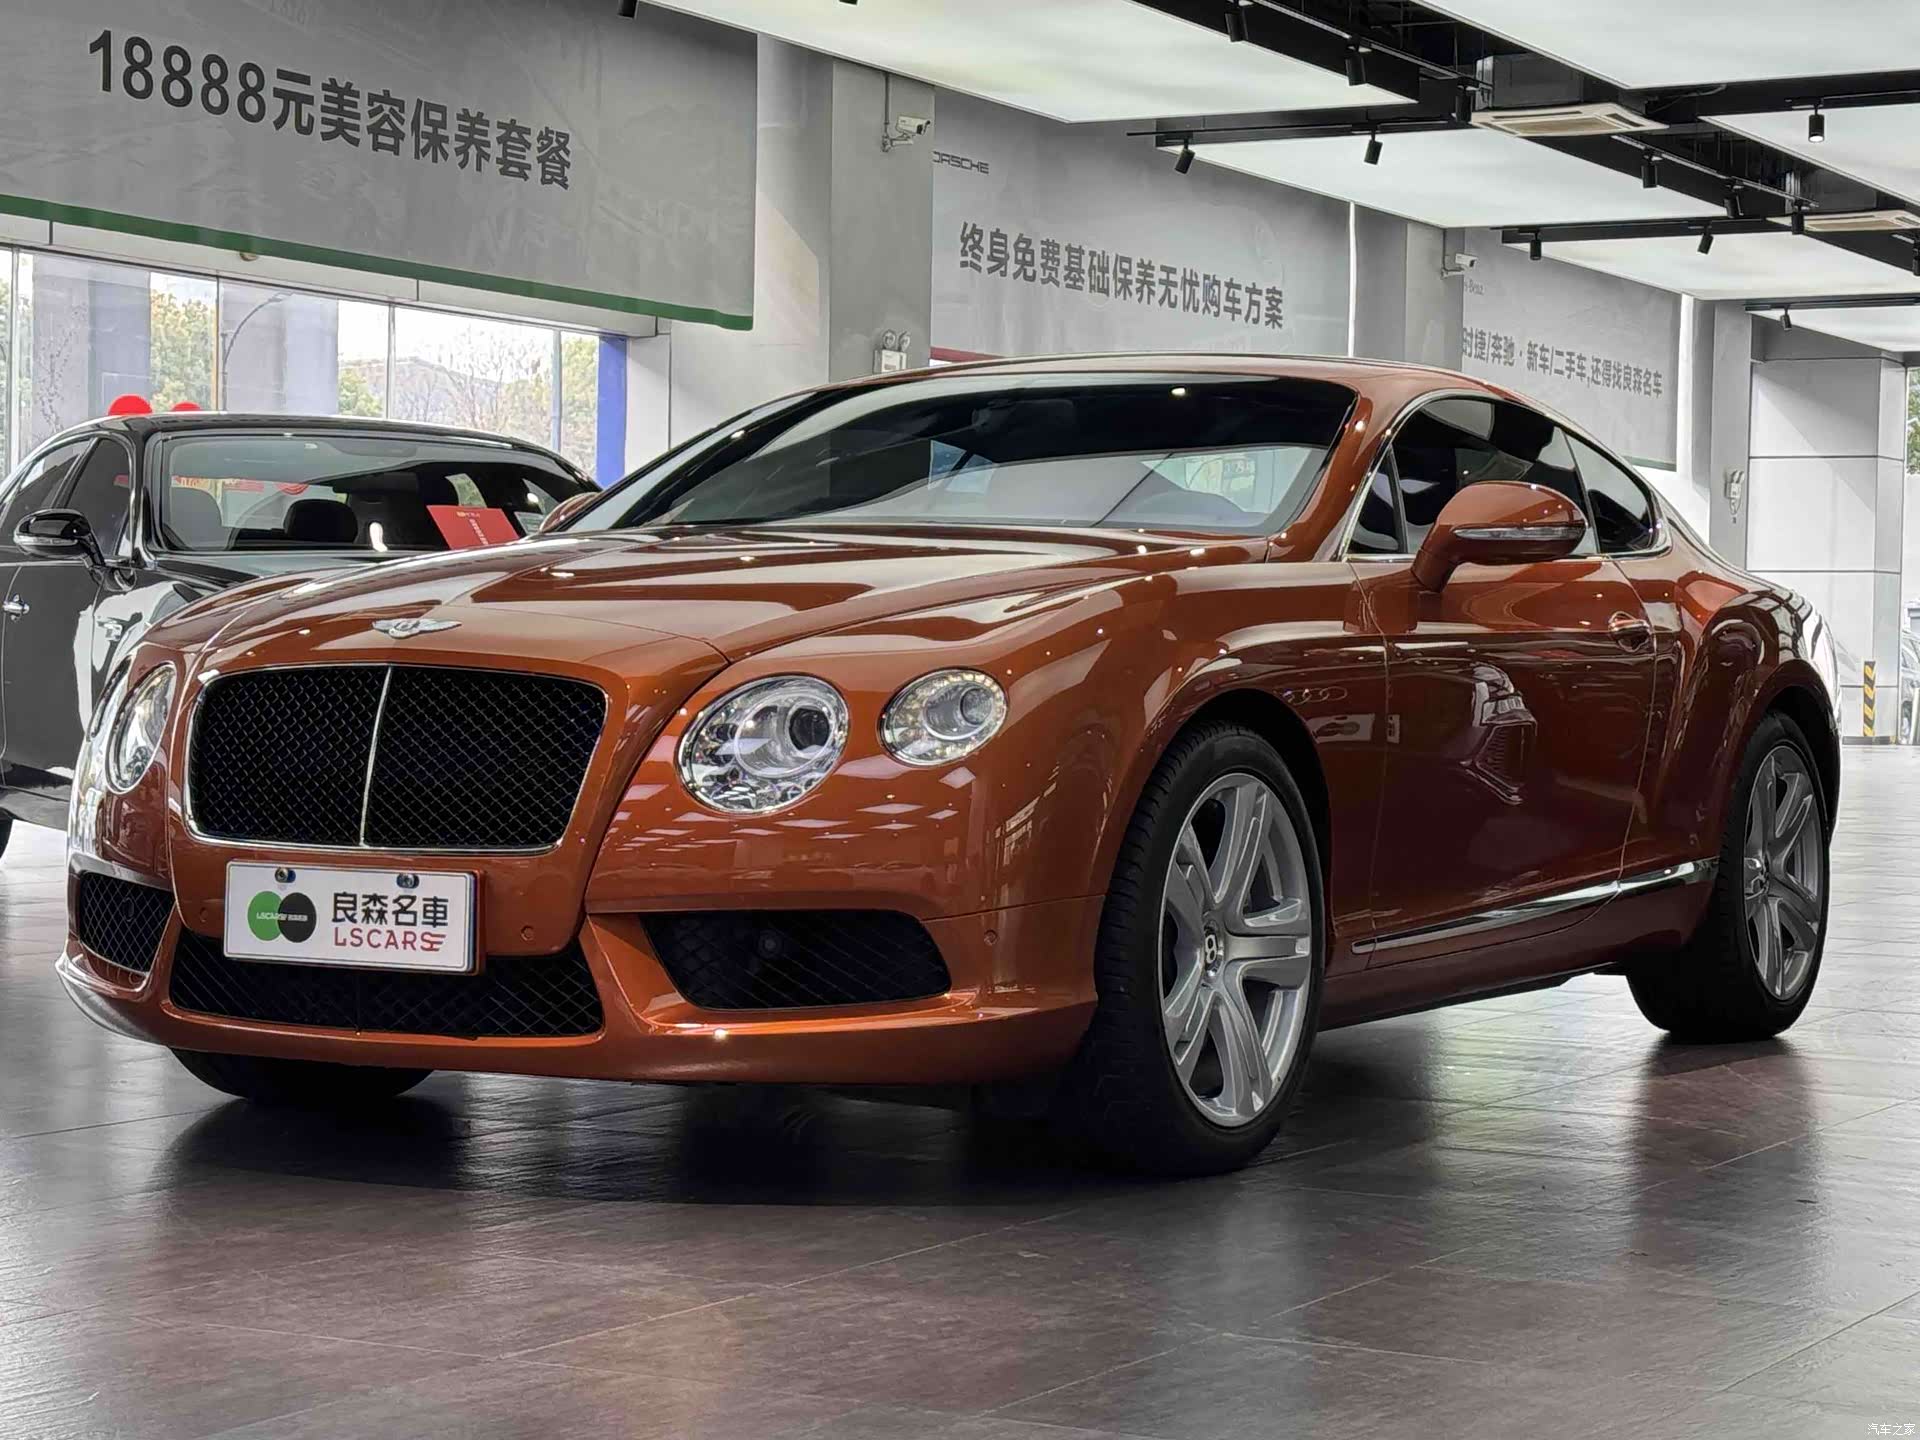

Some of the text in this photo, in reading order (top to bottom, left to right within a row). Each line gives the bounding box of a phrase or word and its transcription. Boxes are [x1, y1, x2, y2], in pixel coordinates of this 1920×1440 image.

[89, 29, 571, 190] 18888元美容保养套餐
[959, 221, 1284, 330] 终身免费基础保养无忧购车方案
[332, 891, 448, 928] 良森名車
[334, 926, 446, 952] LSCARS
